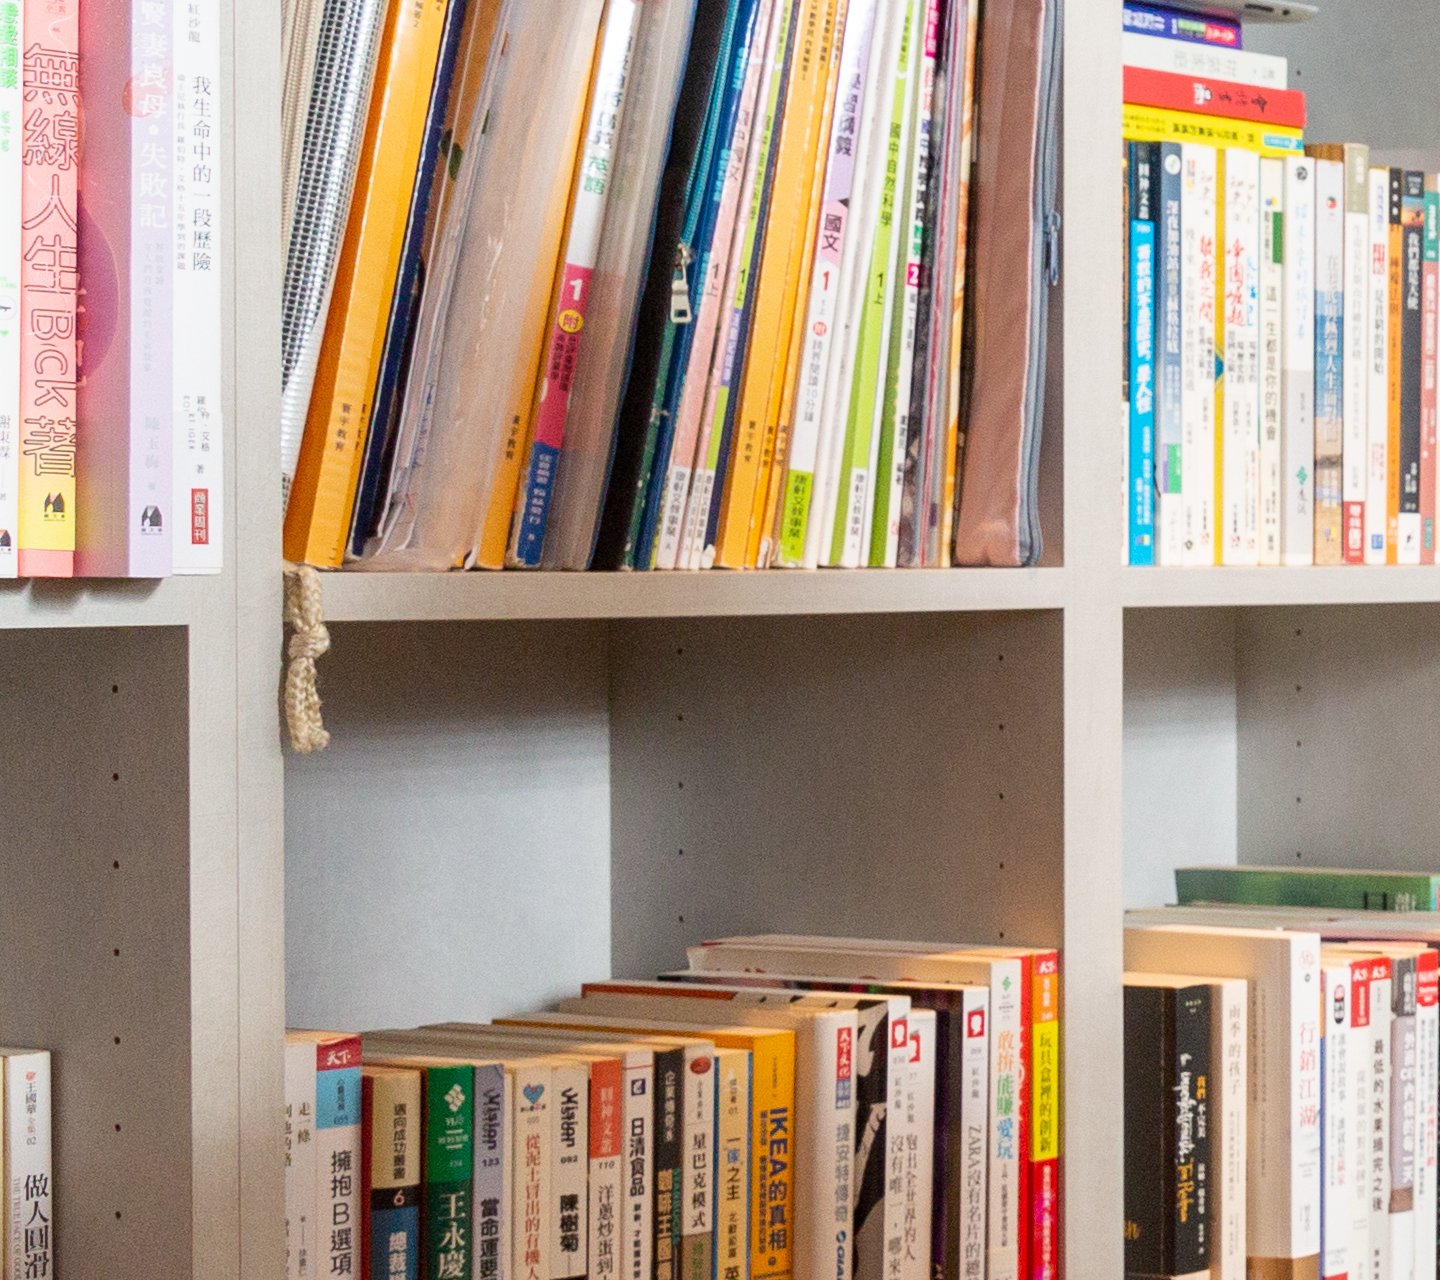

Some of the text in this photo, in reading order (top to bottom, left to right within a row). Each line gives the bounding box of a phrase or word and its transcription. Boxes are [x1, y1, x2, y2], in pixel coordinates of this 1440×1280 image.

[188, 2, 202, 44] 紅沙龍
[192, 75, 213, 272] 我生命中的一段歷險
[821, 212, 843, 254] 國文
[568, 277, 584, 301] 1
[822, 270, 831, 291] 1
[1265, 285, 1278, 442] 這一生都是你的機會
[193, 490, 208, 543] 商業周刊
[326, 1049, 352, 1067] 天下
[837, 1026, 852, 1080] 天下文化
[1299, 1021, 1317, 1128] 行銷江湖
[628, 1118, 646, 1198] 日清食品
[1372, 1038, 1385, 1213] 最低的水果摘完之後
[330, 1149, 354, 1277] 擁抱B選項
[690, 1132, 708, 1230] 星巴克模式
[766, 1106, 790, 1252] IKEA的真相
[559, 1193, 580, 1254] 陳樹菊
